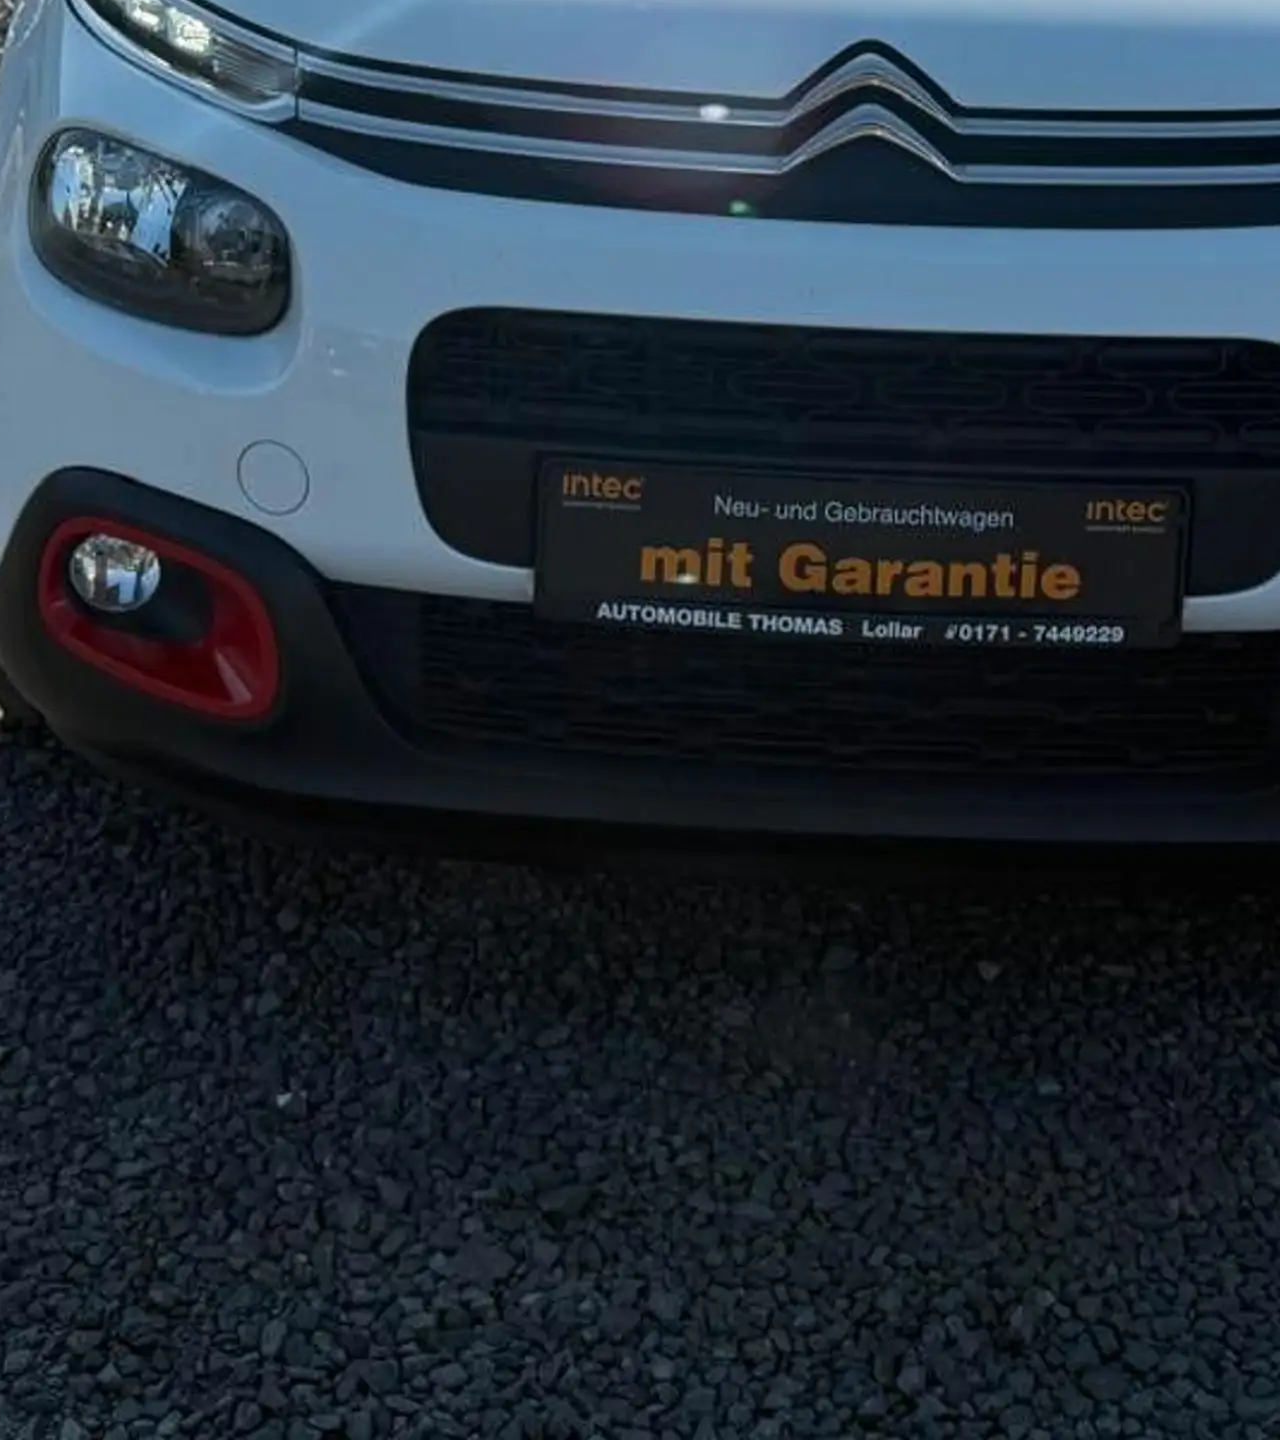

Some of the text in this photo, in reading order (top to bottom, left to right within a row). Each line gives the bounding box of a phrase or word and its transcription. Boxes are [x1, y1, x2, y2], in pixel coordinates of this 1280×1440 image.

[562, 473, 642, 500] intec
[713, 494, 1014, 533] Neu- und Gebrauchtwagen
[639, 537, 1081, 600] mit Garantie
[596, 601, 743, 629] AUTOMOBILE
[748, 613, 844, 636] THOMAS
[861, 618, 924, 639] Lollar
[1033, 625, 1124, 644] 7449229
